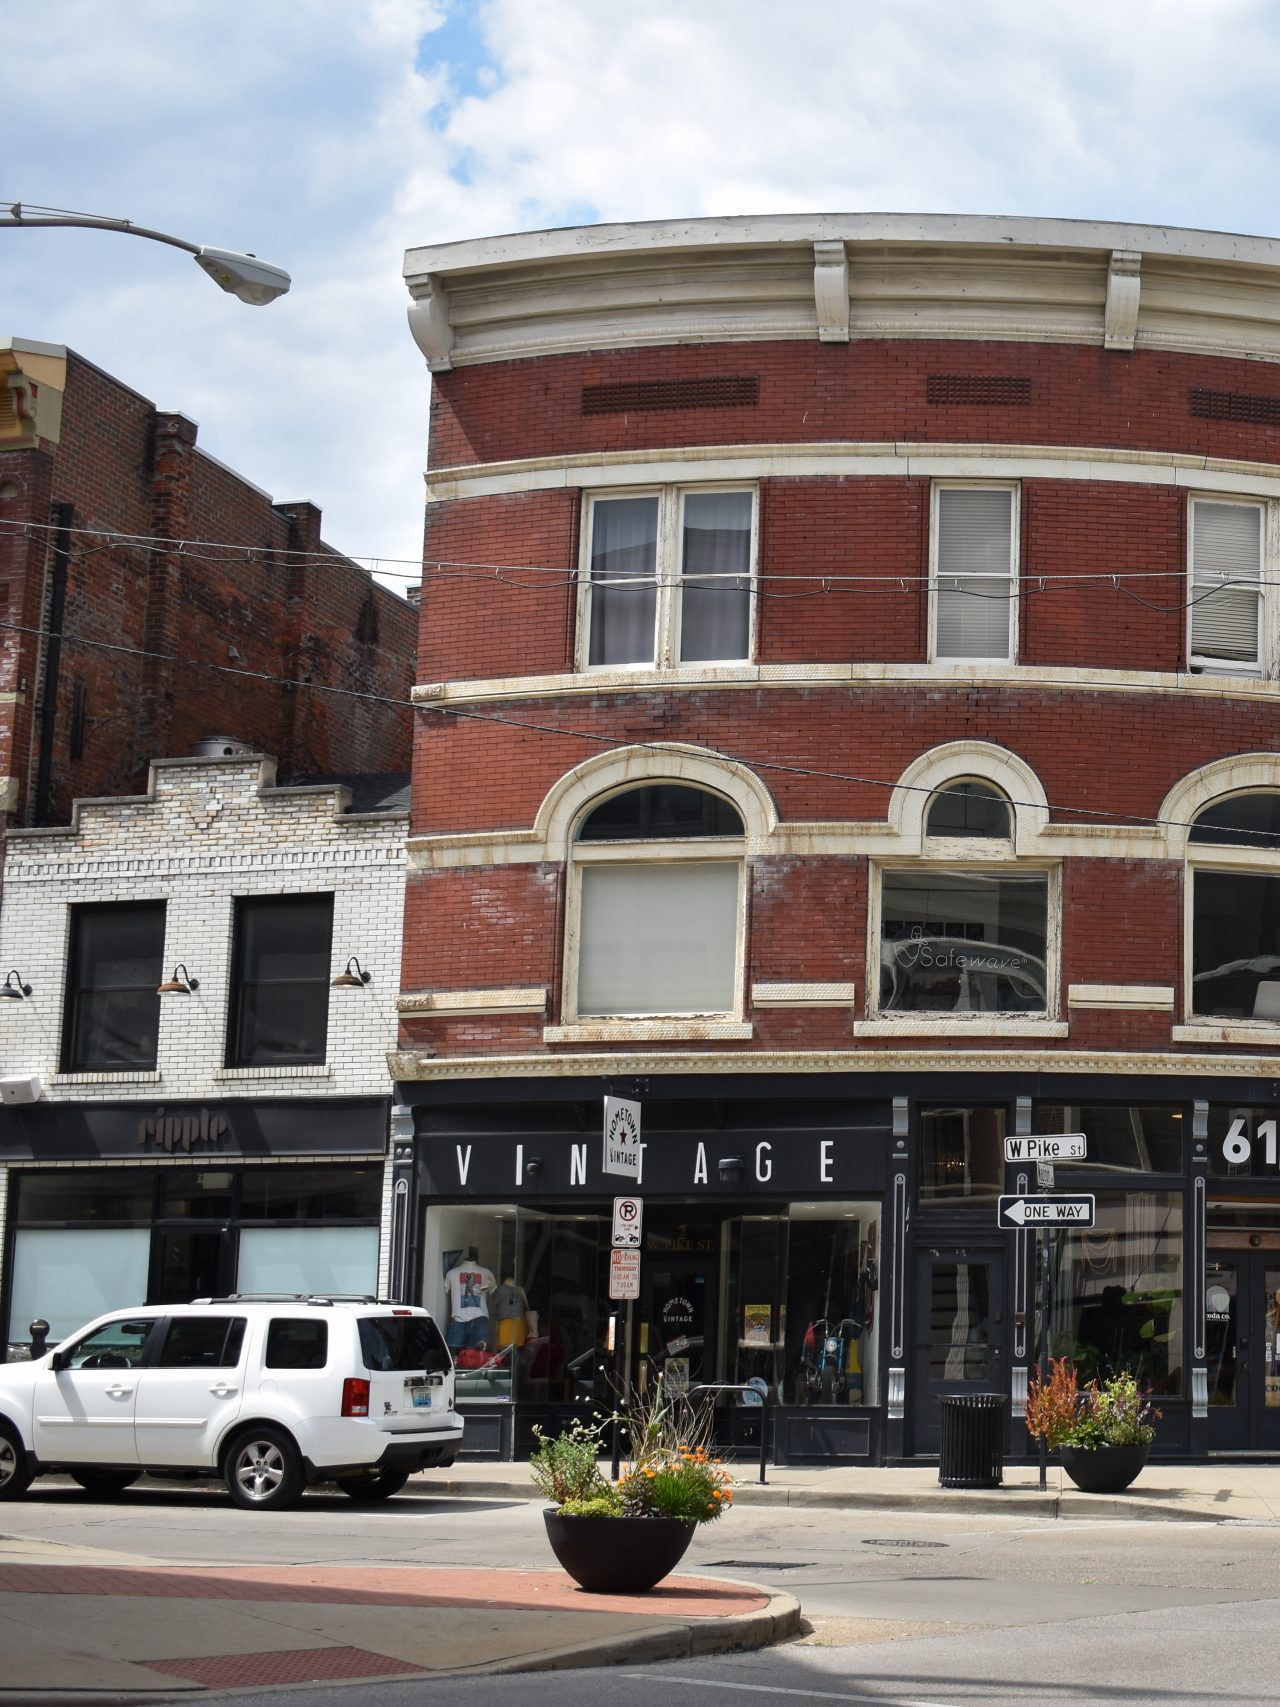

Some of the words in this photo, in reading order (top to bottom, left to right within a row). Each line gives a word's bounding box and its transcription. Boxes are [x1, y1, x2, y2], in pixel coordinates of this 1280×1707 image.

[920, 946, 1020, 969] Safewave
[138, 1106, 228, 1152] ripple
[609, 1107, 638, 1145] HOMETOWN
[610, 1147, 637, 1167] VINTAGE
[1010, 1140, 1022, 1158] W
[1027, 1139, 1060, 1157] Pike
[1070, 1144, 1082, 1156] St
[1024, 1205, 1050, 1218] ONE
[1056, 1205, 1083, 1218] WAY
[662, 1297, 695, 1313] HOMETOWN
